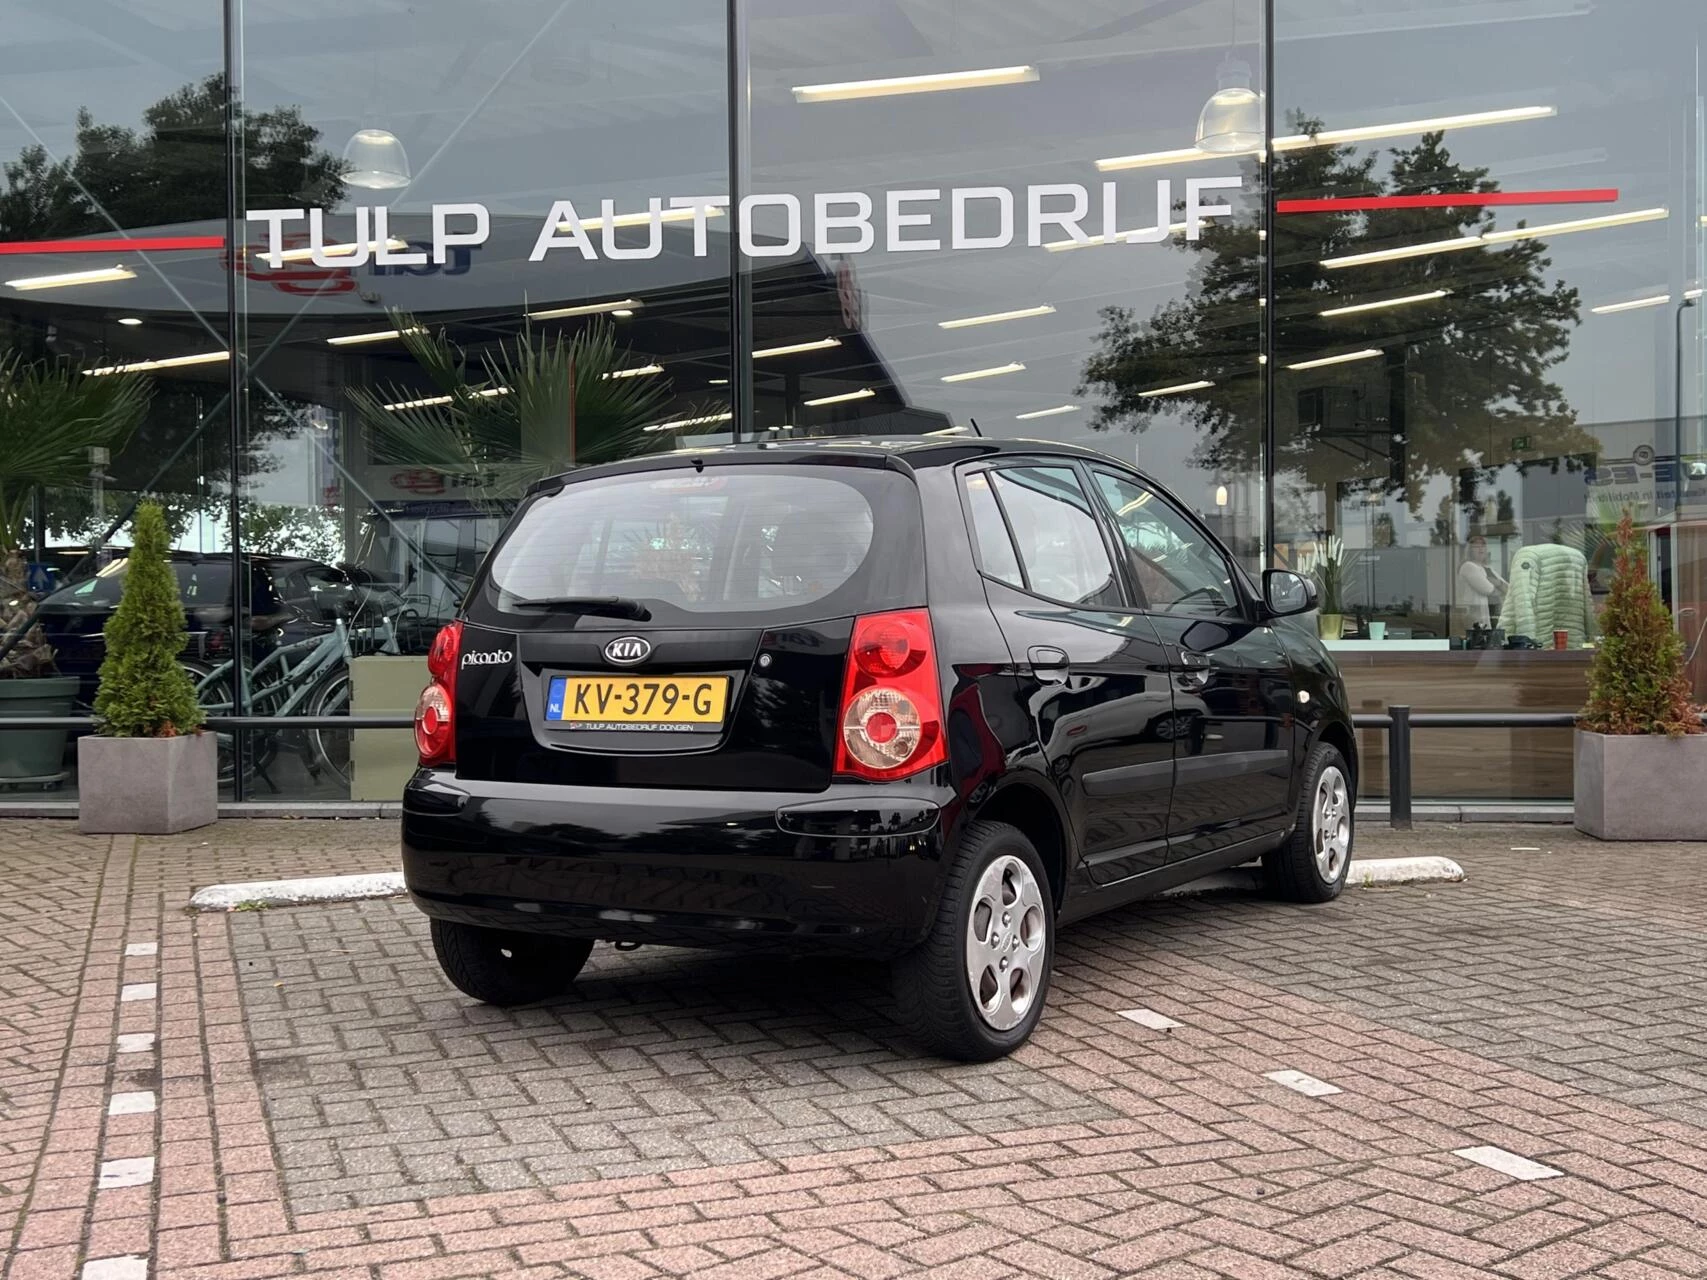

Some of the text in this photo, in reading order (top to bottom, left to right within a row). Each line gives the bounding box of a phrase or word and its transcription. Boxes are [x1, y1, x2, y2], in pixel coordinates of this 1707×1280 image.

[246, 203, 490, 269] TULP
[528, 176, 1243, 262] AUTOBEDRIJF
[612, 642, 642, 657] KIA
[461, 649, 513, 670] picanto
[549, 703, 561, 713] NL
[573, 683, 712, 716] KV-379-G
[586, 723, 605, 731] TULP
